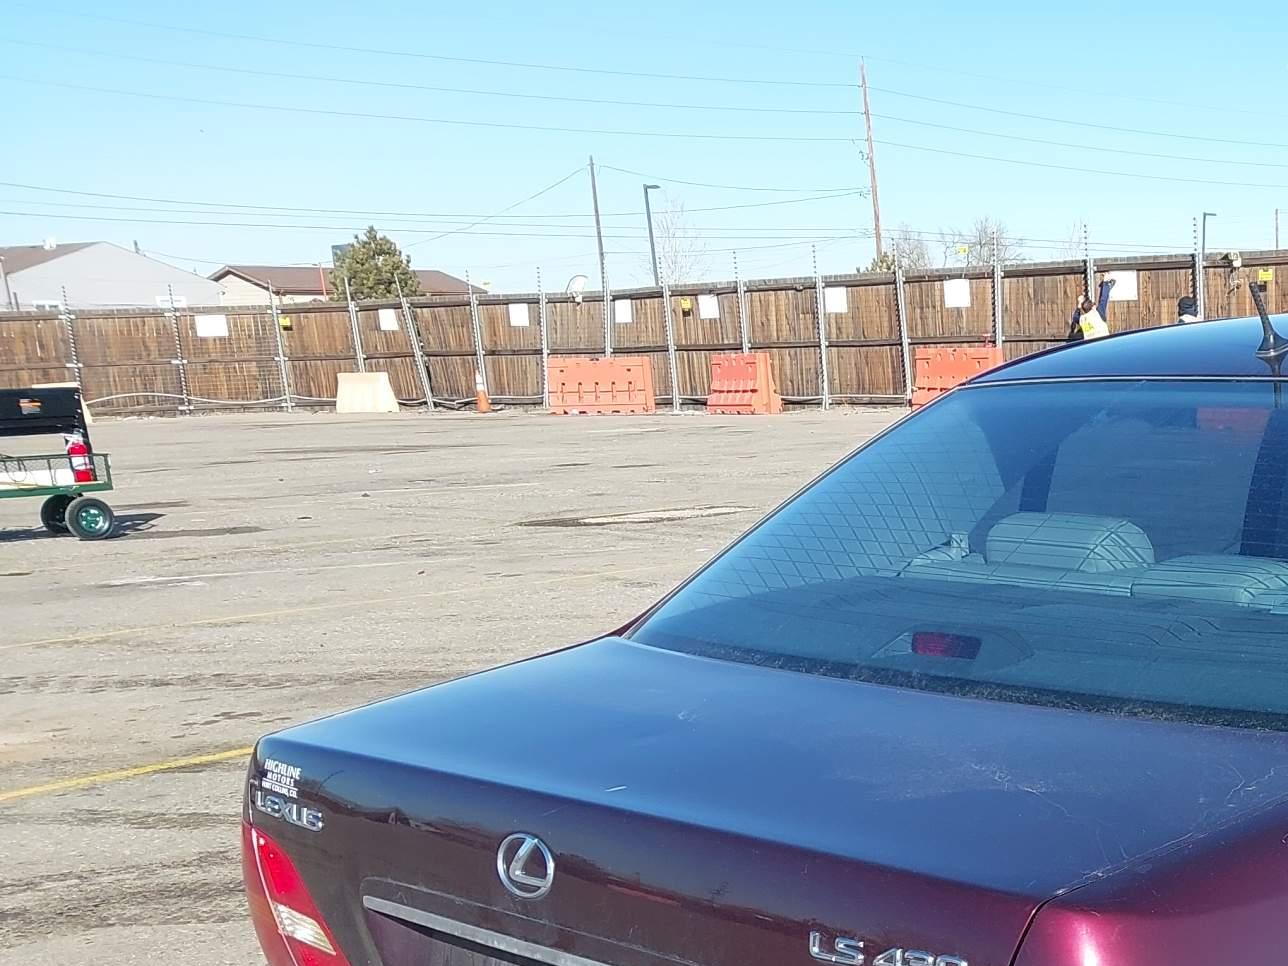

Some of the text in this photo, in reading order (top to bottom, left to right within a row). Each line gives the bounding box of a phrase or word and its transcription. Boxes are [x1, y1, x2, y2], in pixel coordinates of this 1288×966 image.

[264, 758, 302, 780] HIGHLINE
[266, 771, 296, 787] MOTORS
[255, 790, 324, 832] LEXUS
[809, 930, 865, 966] LS
